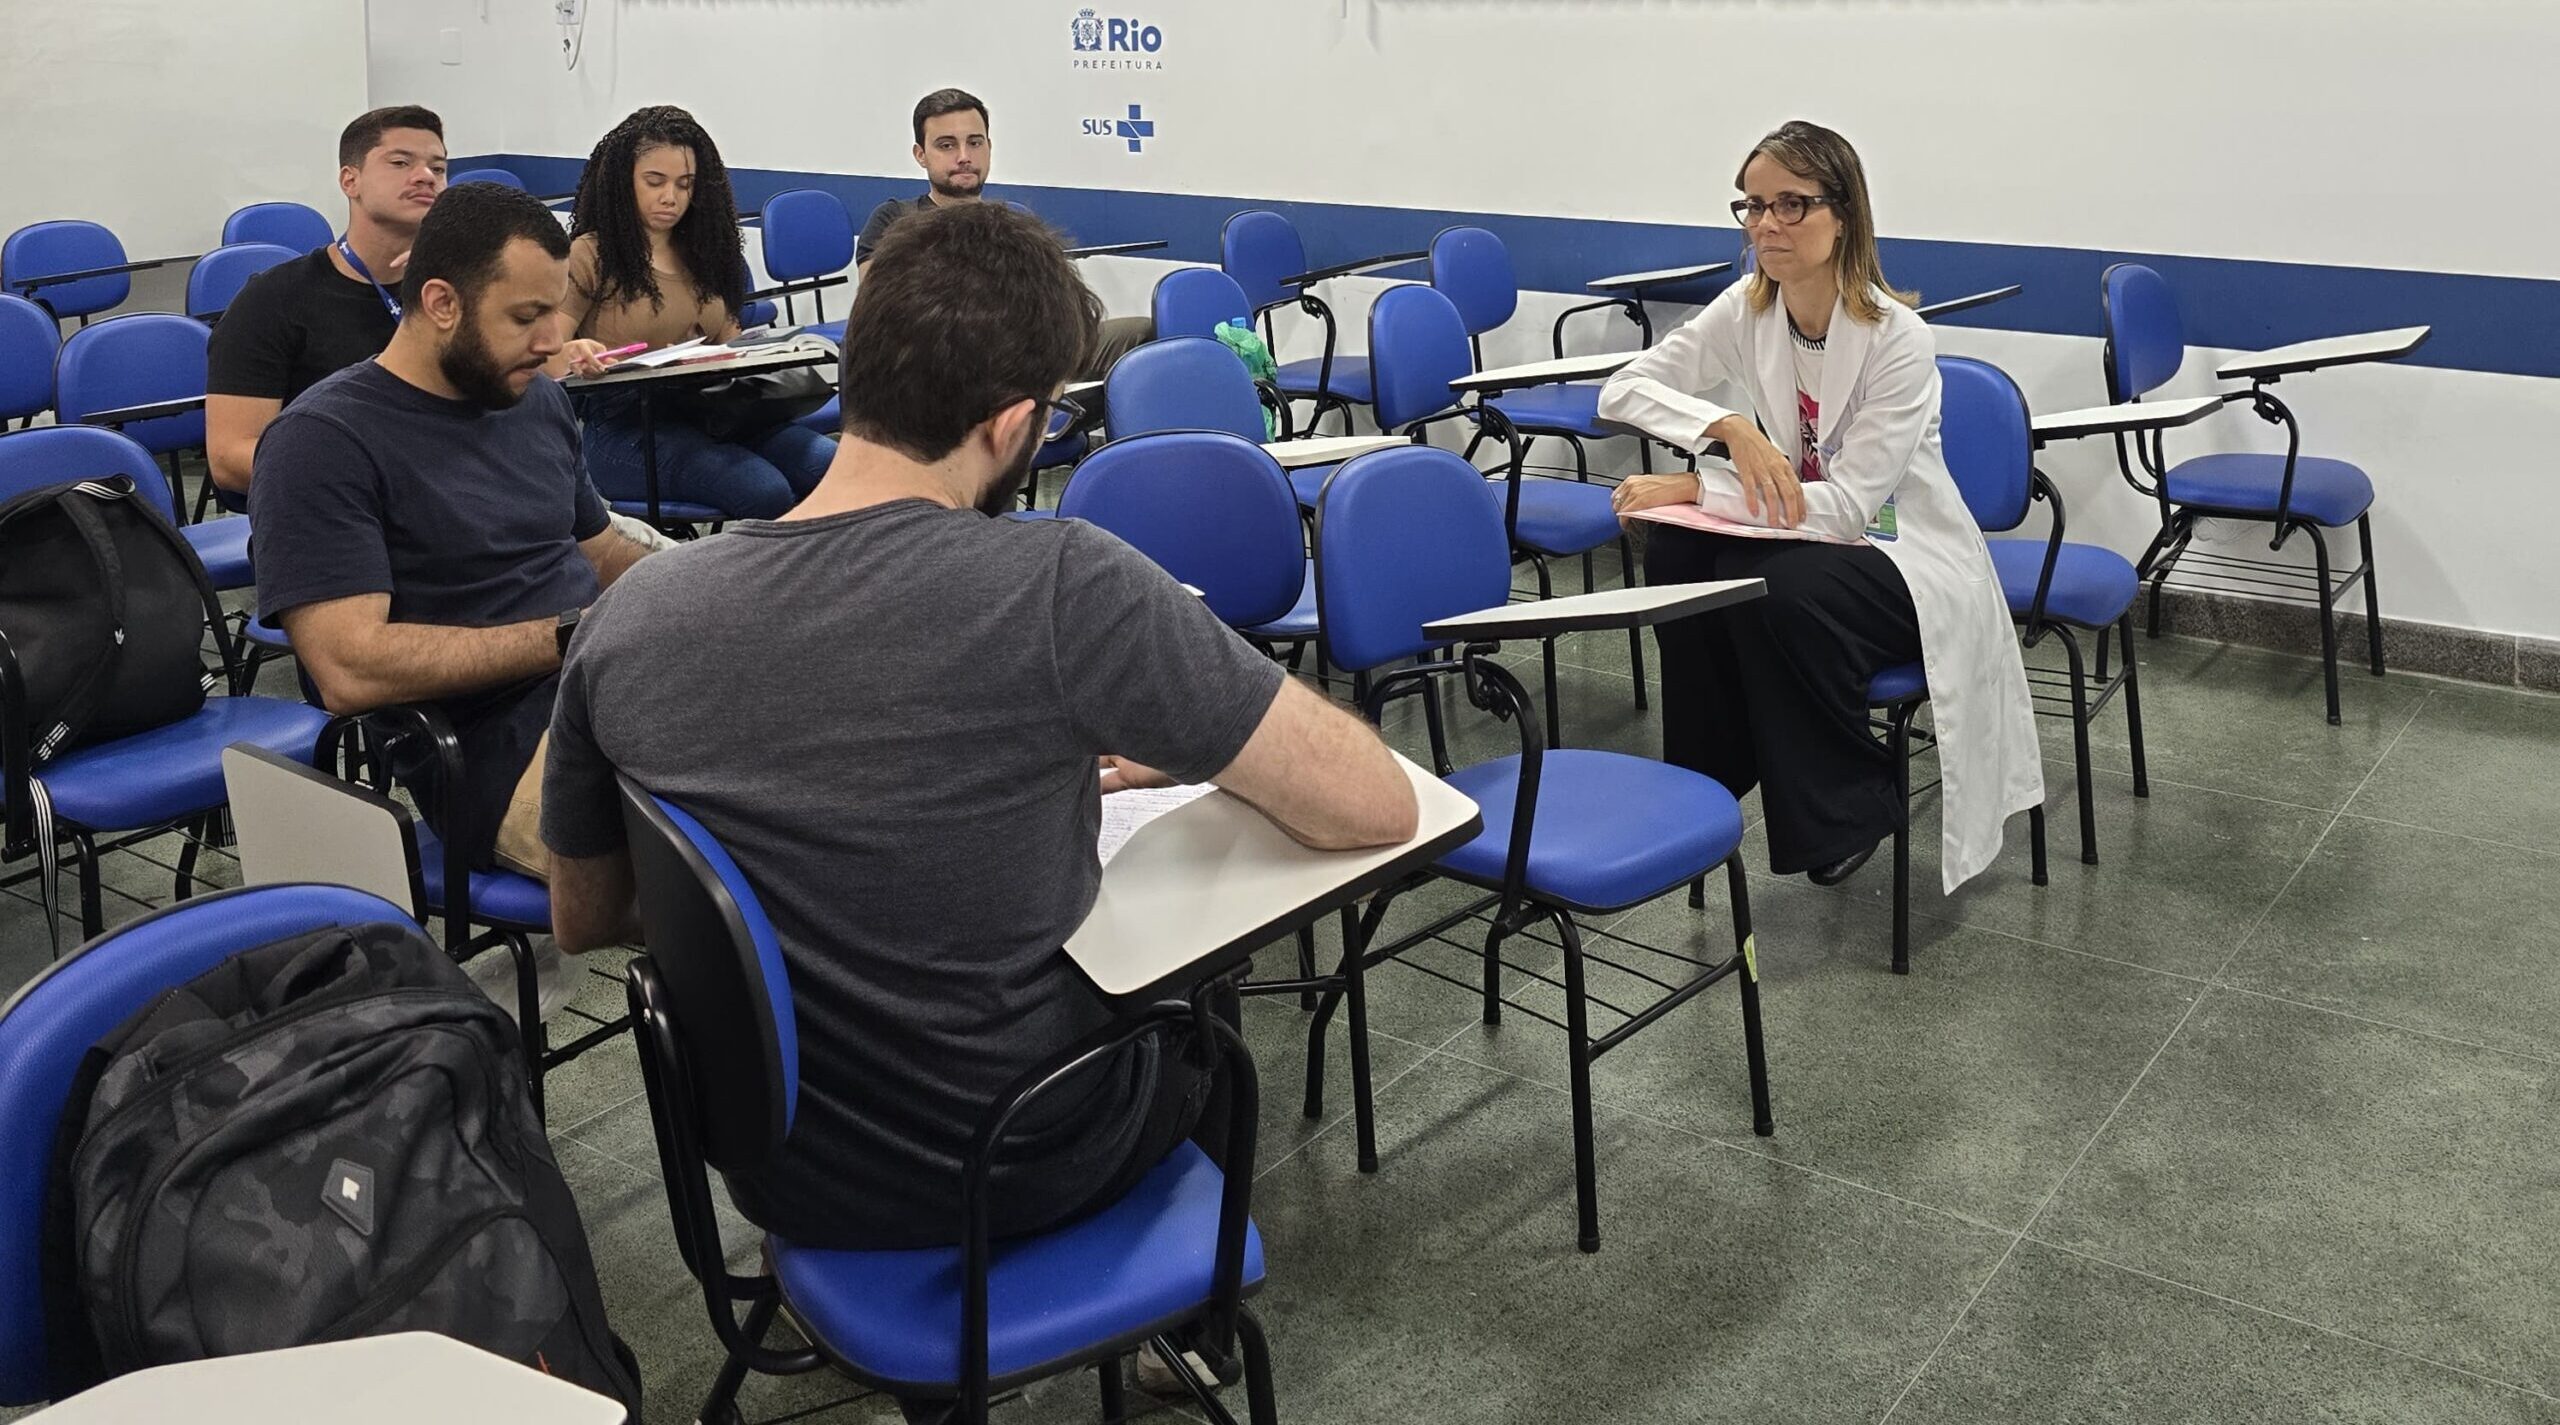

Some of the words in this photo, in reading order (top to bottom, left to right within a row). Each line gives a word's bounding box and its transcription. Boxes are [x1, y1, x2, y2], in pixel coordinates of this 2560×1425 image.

[1108, 18, 1162, 52] Rio
[1073, 60, 1162, 70] PREFEITURA
[1082, 119, 1112, 135] SUS
